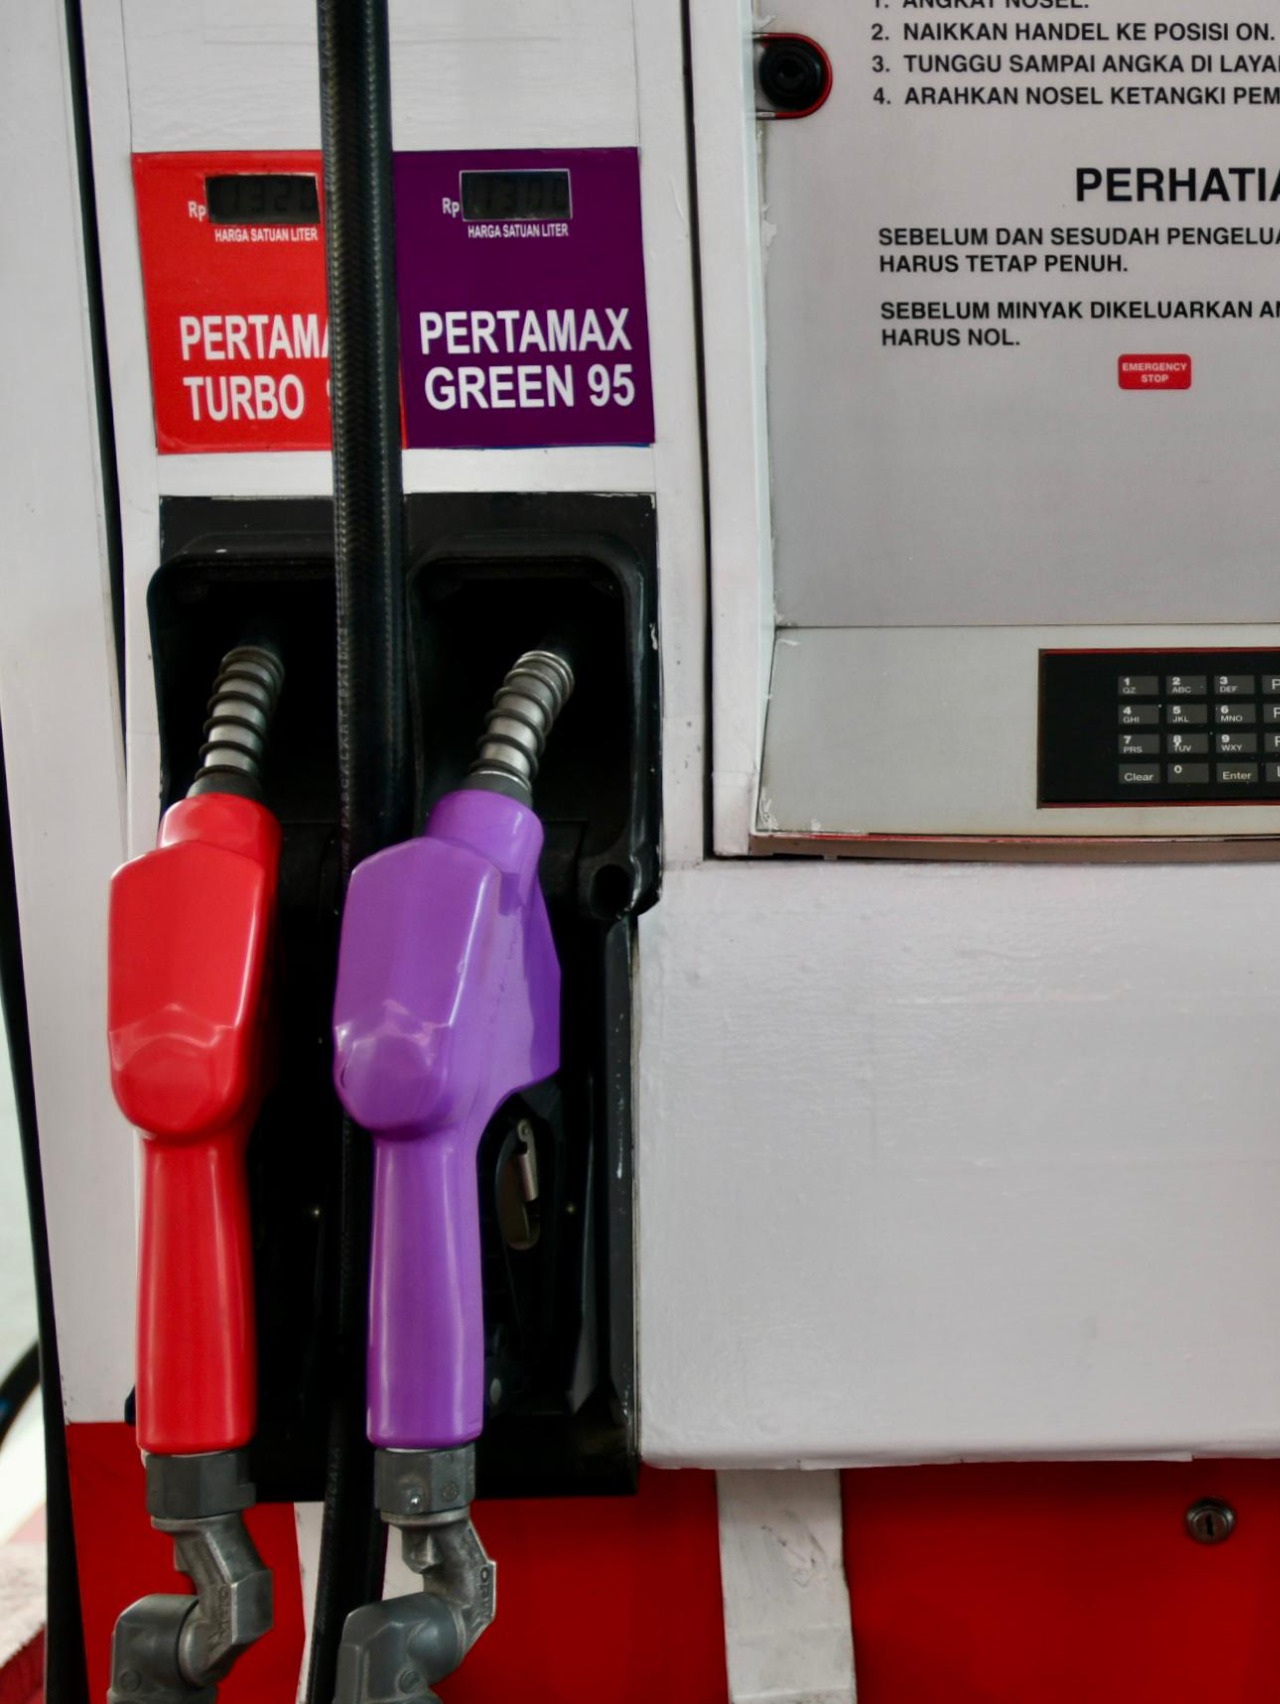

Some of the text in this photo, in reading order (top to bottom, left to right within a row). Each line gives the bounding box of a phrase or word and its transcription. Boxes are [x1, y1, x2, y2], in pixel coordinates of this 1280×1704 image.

[871, 22, 1275, 41] 2. NAIKKAN HANDEL KE POSISI ON.
[872, 55, 890, 73] 3.
[903, 54, 1002, 73] TUNGGU
[1009, 54, 1095, 73] SAMPAI
[1102, 54, 1184, 73] ANGKA
[1191, 54, 1212, 73] DI
[873, 87, 891, 105] 4.
[904, 86, 1018, 105] ARAHKAN
[1026, 86, 1103, 105] NOSEL
[1110, 86, 1225, 105] KETANGKI
[188, 200, 207, 221] Rp
[442, 197, 461, 218] Rp
[215, 227, 318, 242] HARGA SATUAN LITER
[468, 223, 569, 238] HARGA SATUAN LITER
[879, 227, 988, 246] SEBELUM
[996, 227, 1043, 246] DAN
[1050, 227, 1159, 246] SESUDAH
[879, 254, 1128, 273] HARUS TETAP PENUH.
[881, 301, 990, 320] SEBELUM
[997, 301, 1083, 319] MINYAK
[1090, 300, 1253, 319] DIKELUARKAN
[419, 308, 632, 355] PERTAMAX
[180, 313, 329, 361] PERTAM
[882, 328, 1020, 347] HARUS NOL.
[1122, 362, 1187, 372] EMERGENCY
[1141, 373, 1169, 383] STOP
[424, 363, 635, 411] GREEN 95
[183, 373, 305, 421] TURBO
[1123, 677, 1131, 686] 1
[1172, 677, 1181, 685] 2
[1219, 676, 1229, 685] 3
[1171, 686, 1192, 694] ABC
[1219, 685, 1238, 693] DEF
[1122, 706, 1132, 715] 4
[1172, 706, 1181, 715] 5
[1220, 705, 1229, 714] 6
[1123, 735, 1132, 745] 7
[1172, 735, 1182, 744] 8
[1221, 734, 1230, 743] 9
[1123, 746, 1143, 754] PRS
[1221, 744, 1242, 752] WXY
[1173, 765, 1182, 774] 0
[1124, 772, 1154, 782] Clear
[1222, 771, 1252, 780] Enter
